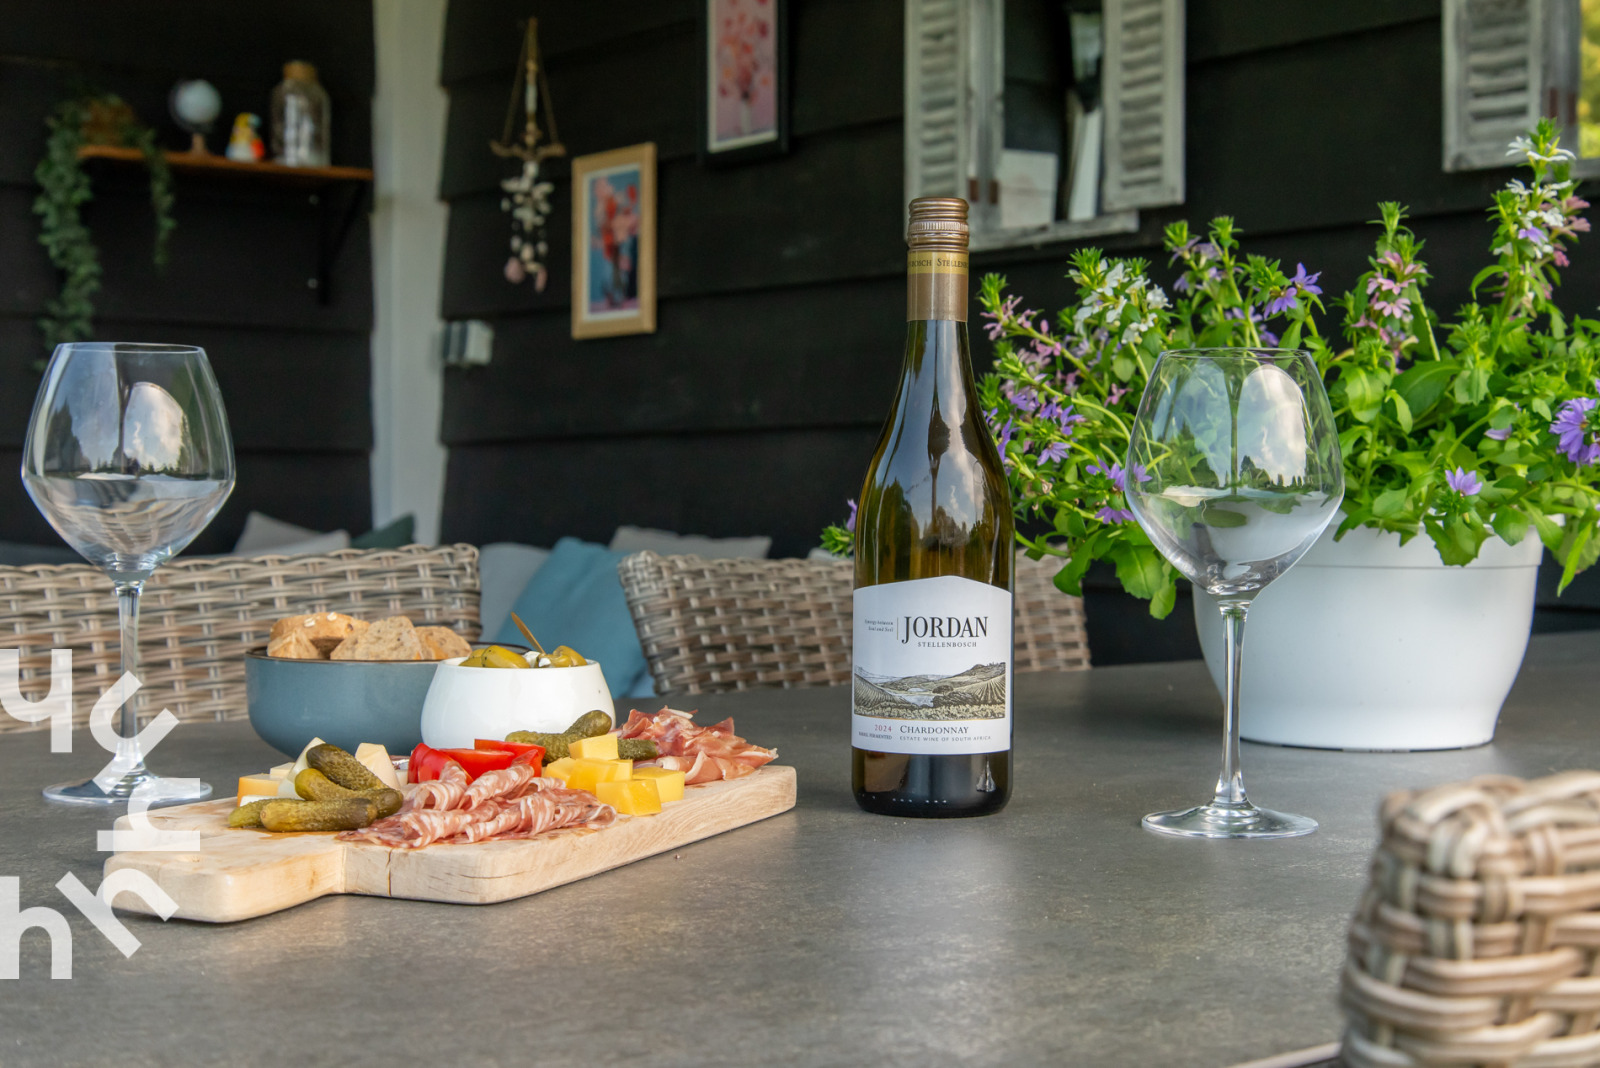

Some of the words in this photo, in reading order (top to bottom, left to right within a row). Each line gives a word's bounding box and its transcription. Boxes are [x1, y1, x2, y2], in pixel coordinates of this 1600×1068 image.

[901, 616, 988, 644] JORDAN
[874, 724, 892, 732] 2024
[900, 725, 969, 735] CHARDONNAY
